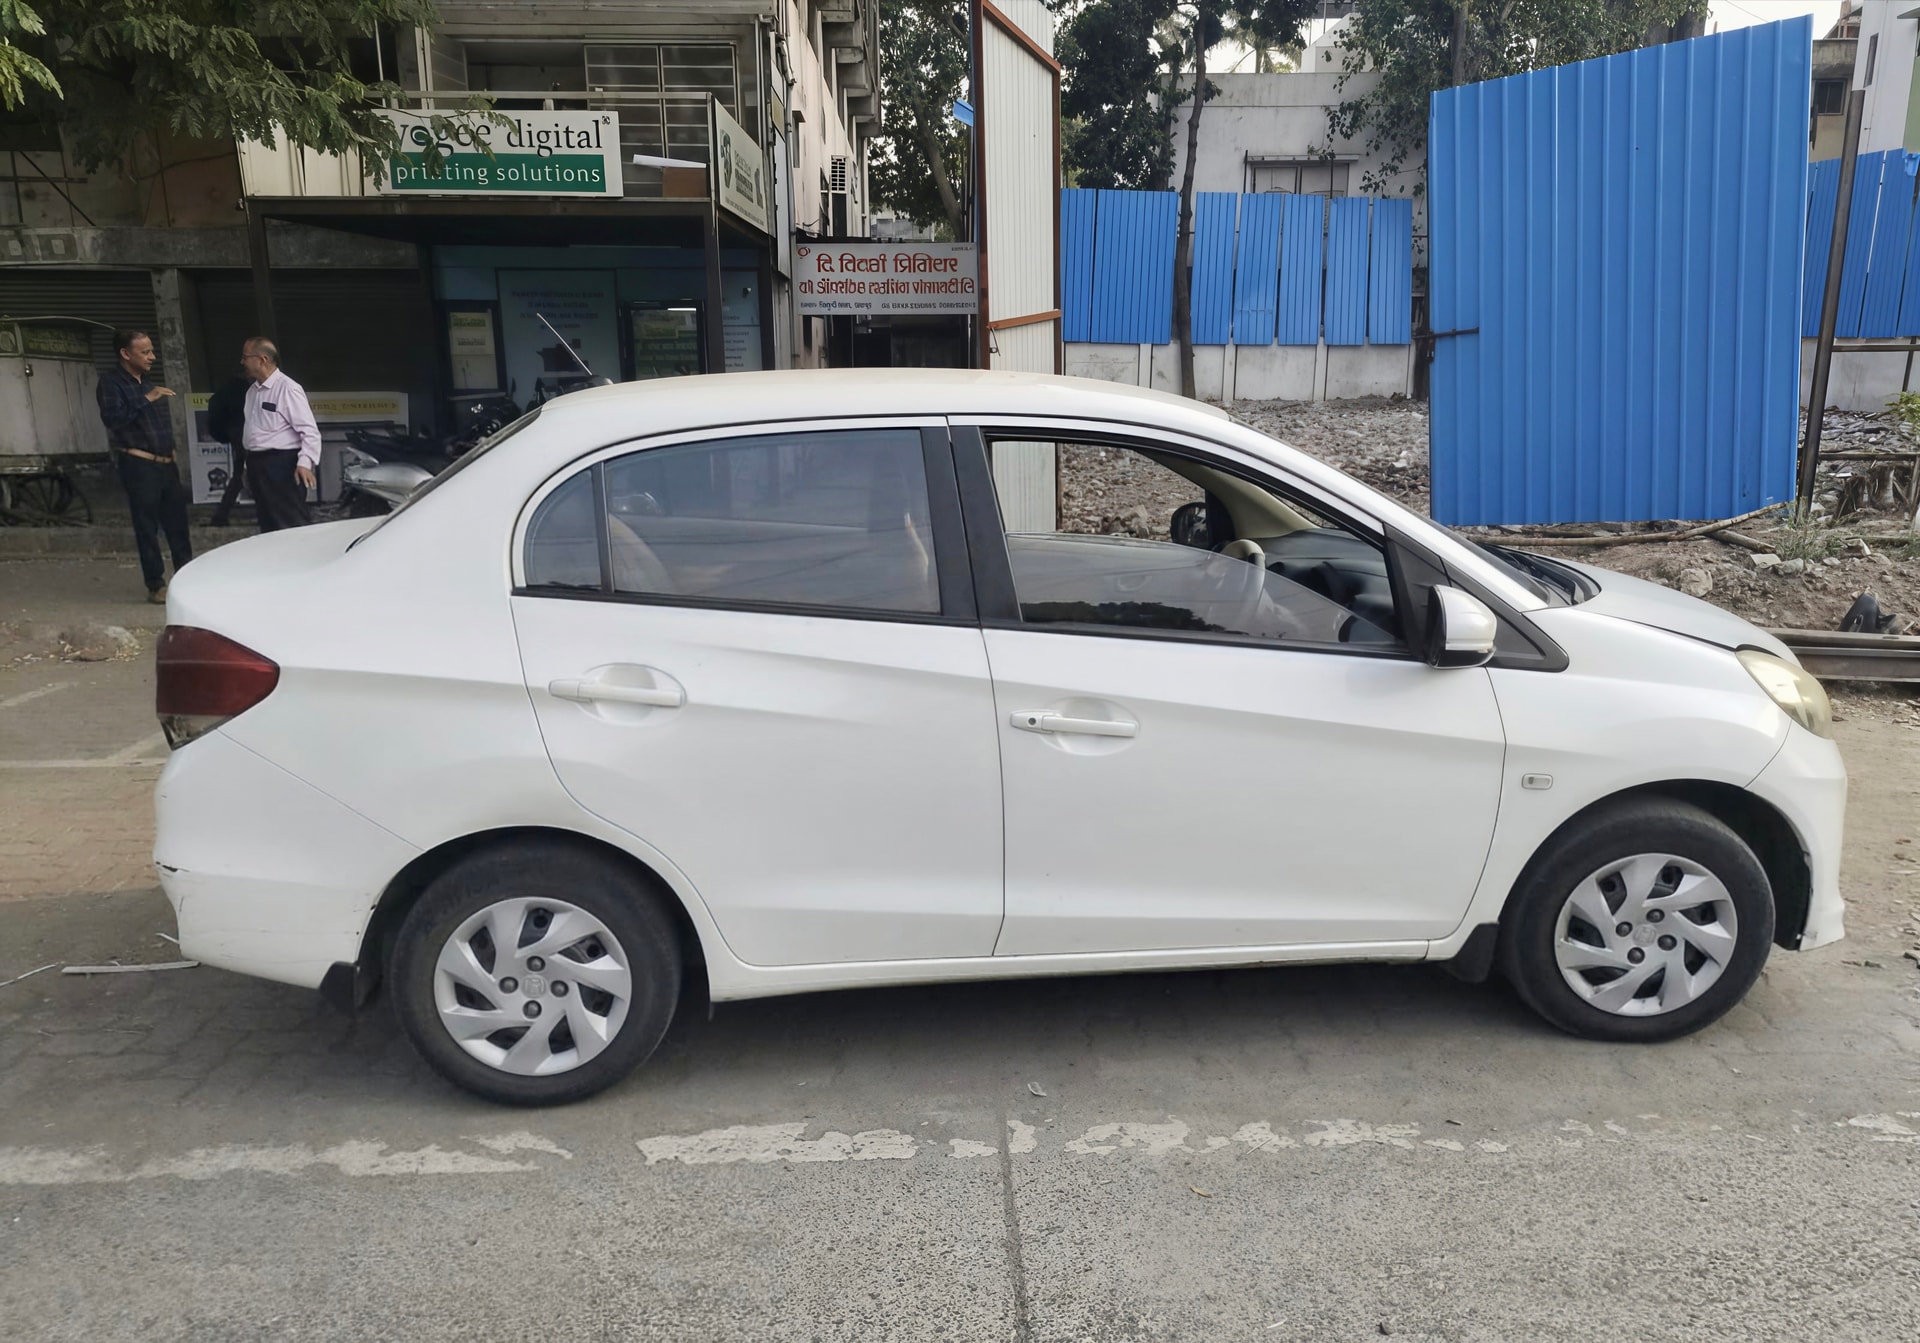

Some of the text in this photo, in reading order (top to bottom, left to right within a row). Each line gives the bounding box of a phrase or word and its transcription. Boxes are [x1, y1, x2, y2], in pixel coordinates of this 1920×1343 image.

[506, 119, 603, 157] digital
[396, 162, 600, 185] priting solutions
